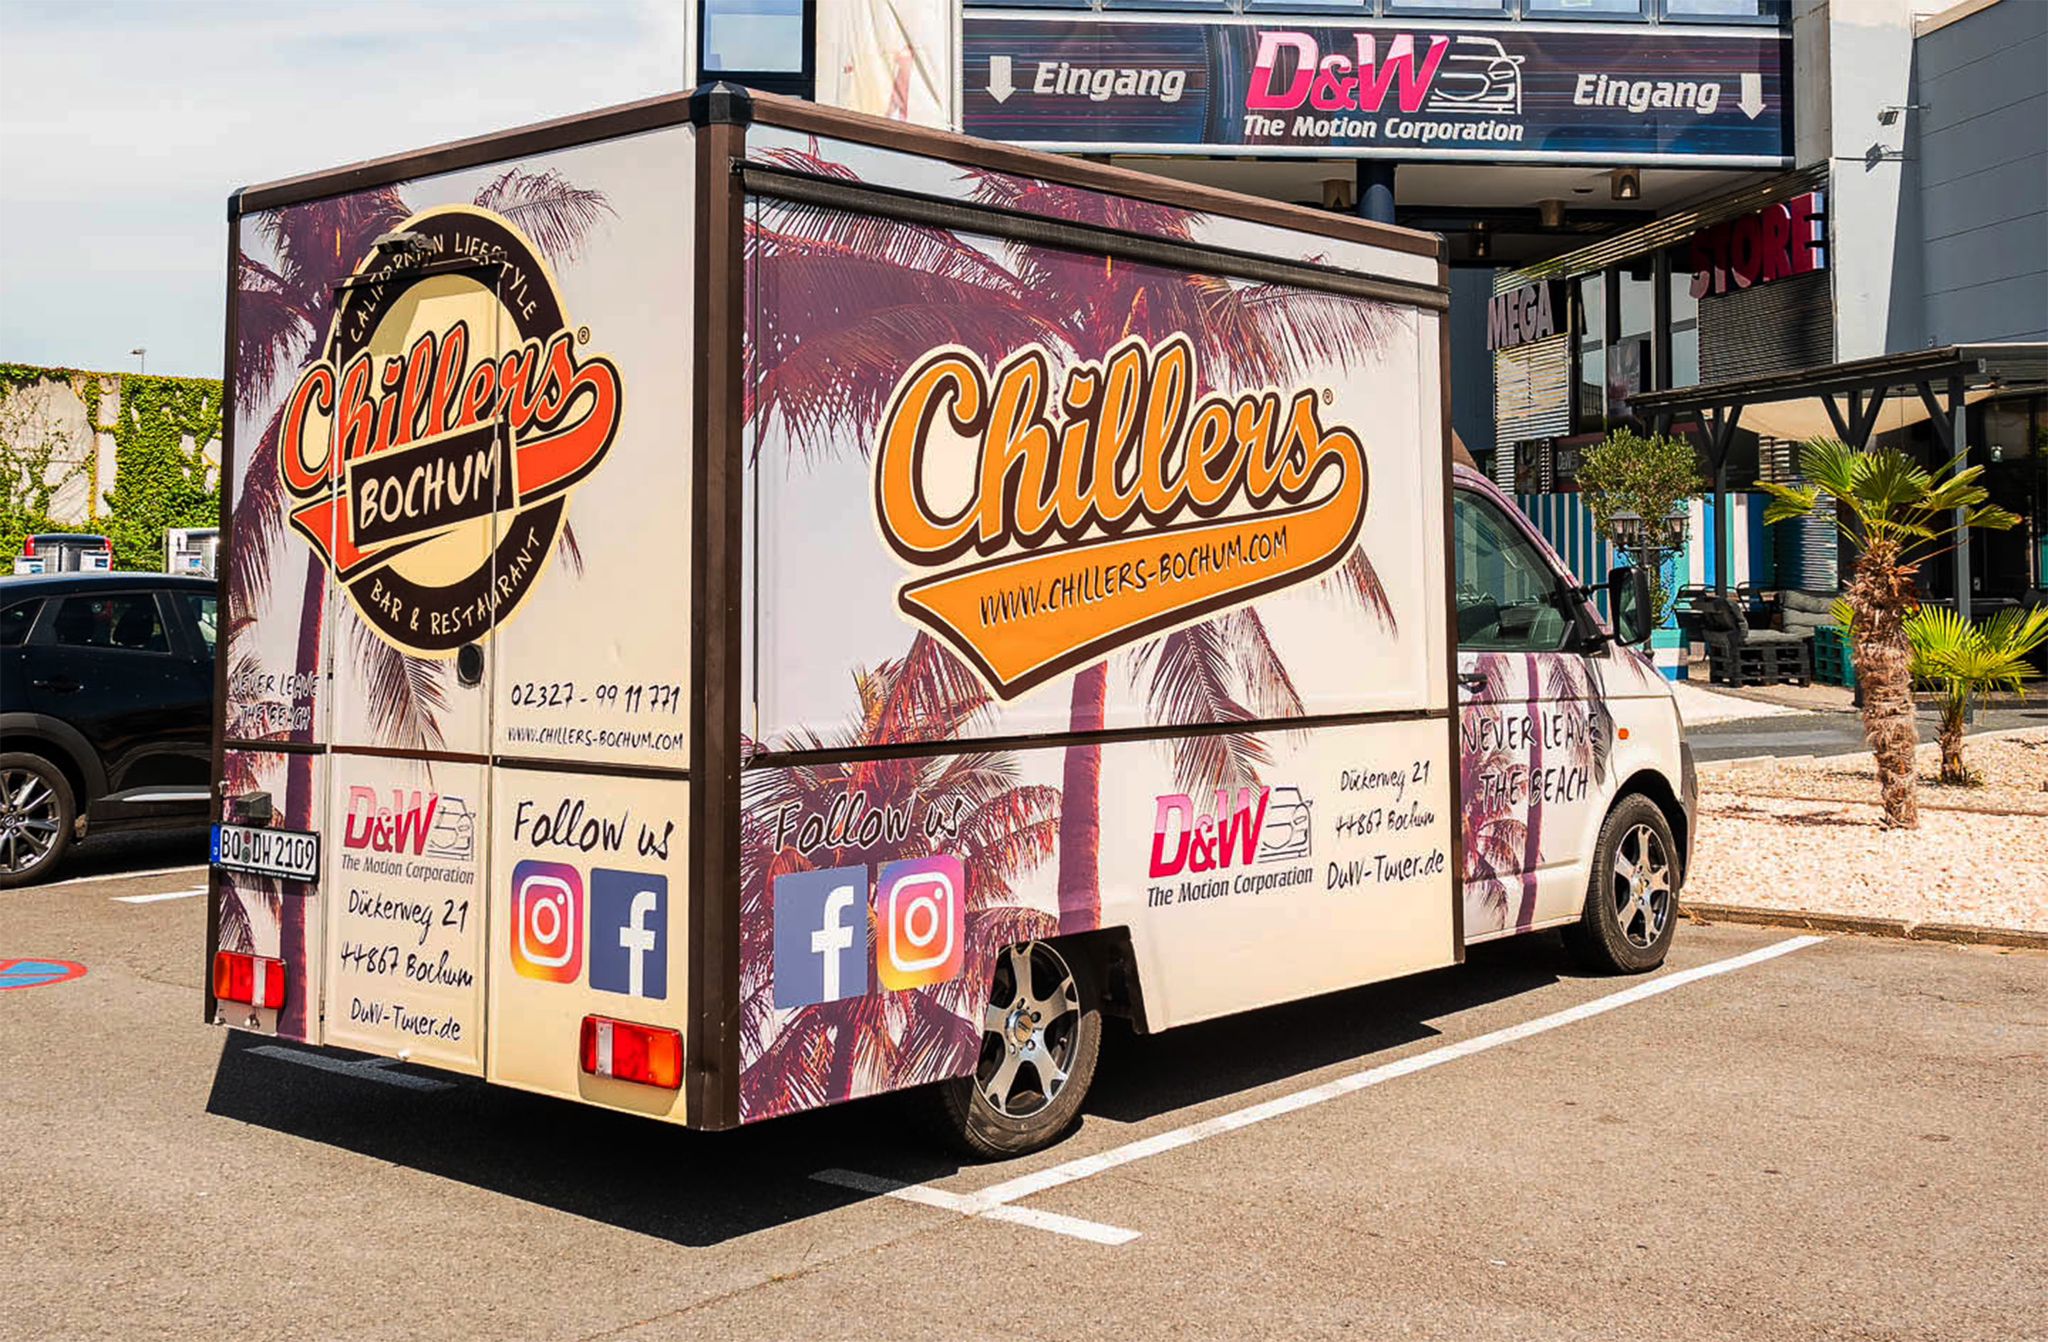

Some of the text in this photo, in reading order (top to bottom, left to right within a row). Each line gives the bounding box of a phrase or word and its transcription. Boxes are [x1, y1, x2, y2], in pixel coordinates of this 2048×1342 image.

[1033, 62, 1187, 102] Eingang
[1245, 31, 1451, 113] D&W
[1573, 73, 1721, 115] Eingang
[1243, 114, 1525, 144] The Motion Corporation
[1487, 191, 1825, 351] MEGA STORE
[282, 321, 620, 499] Chillers
[876, 336, 1368, 566] Chillers
[360, 439, 501, 530] BOCHUM
[370, 526, 540, 636] BAR & RESTAURANT
[511, 682, 574, 708] 02327
[596, 684, 618, 708] 99
[625, 685, 643, 713] 11
[648, 685, 681, 714] 771
[1462, 709, 1598, 755] NEVER LEAVE
[1411, 760, 1431, 786] 21
[1479, 765, 1589, 813] THE BEACH
[343, 785, 439, 857] D&W
[514, 798, 675, 861] Follow us
[774, 789, 965, 856] Follow us
[1148, 784, 1272, 879] D&W
[1387, 800, 1435, 831] Bochum
[221, 829, 241, 860] BO
[275, 836, 315, 872] 2109
[341, 854, 475, 885] The Motion Corporation
[1147, 866, 1314, 908] The Motion Corporation
[442, 899, 469, 933] 21
[340, 941, 474, 988] 44867 Bochum
